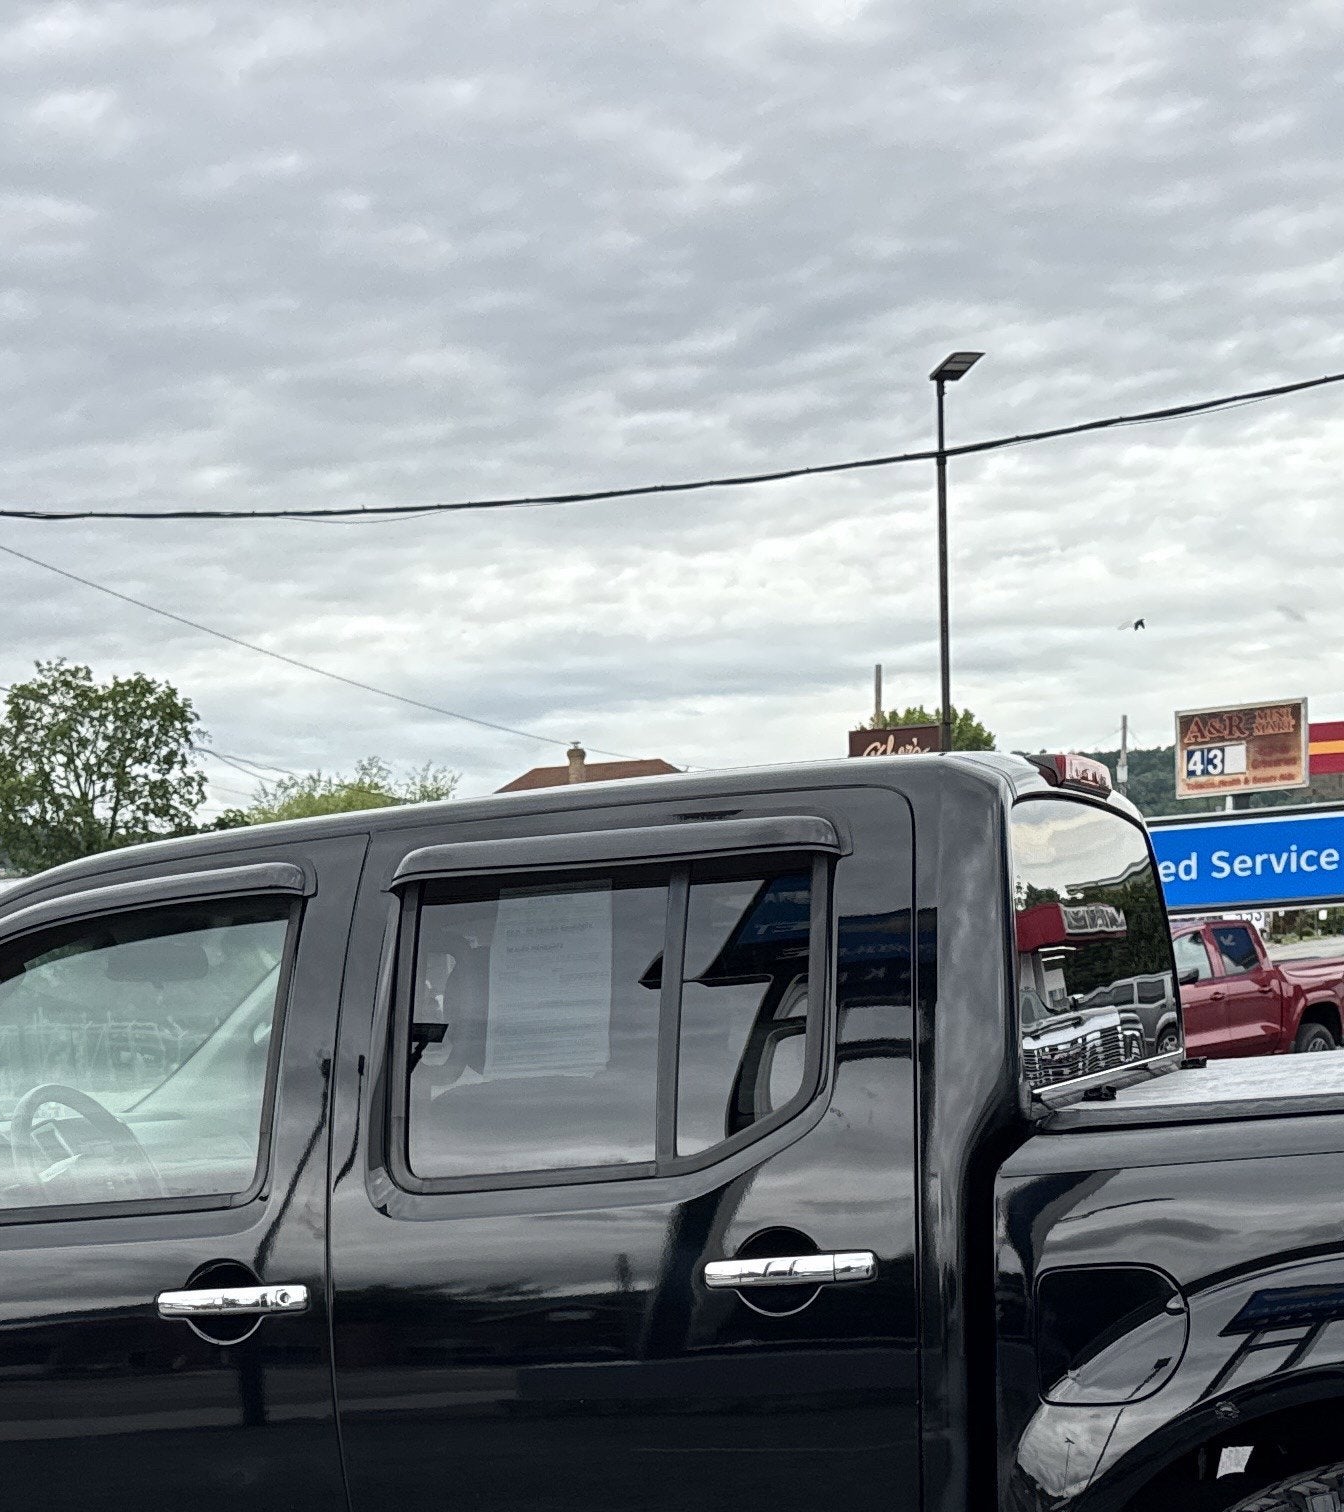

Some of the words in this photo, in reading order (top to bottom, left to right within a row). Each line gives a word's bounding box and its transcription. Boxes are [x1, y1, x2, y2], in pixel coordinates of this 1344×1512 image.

[1184, 714, 1248, 743] A&R
[1187, 749, 1224, 776] 43
[1211, 844, 1340, 879] Service
